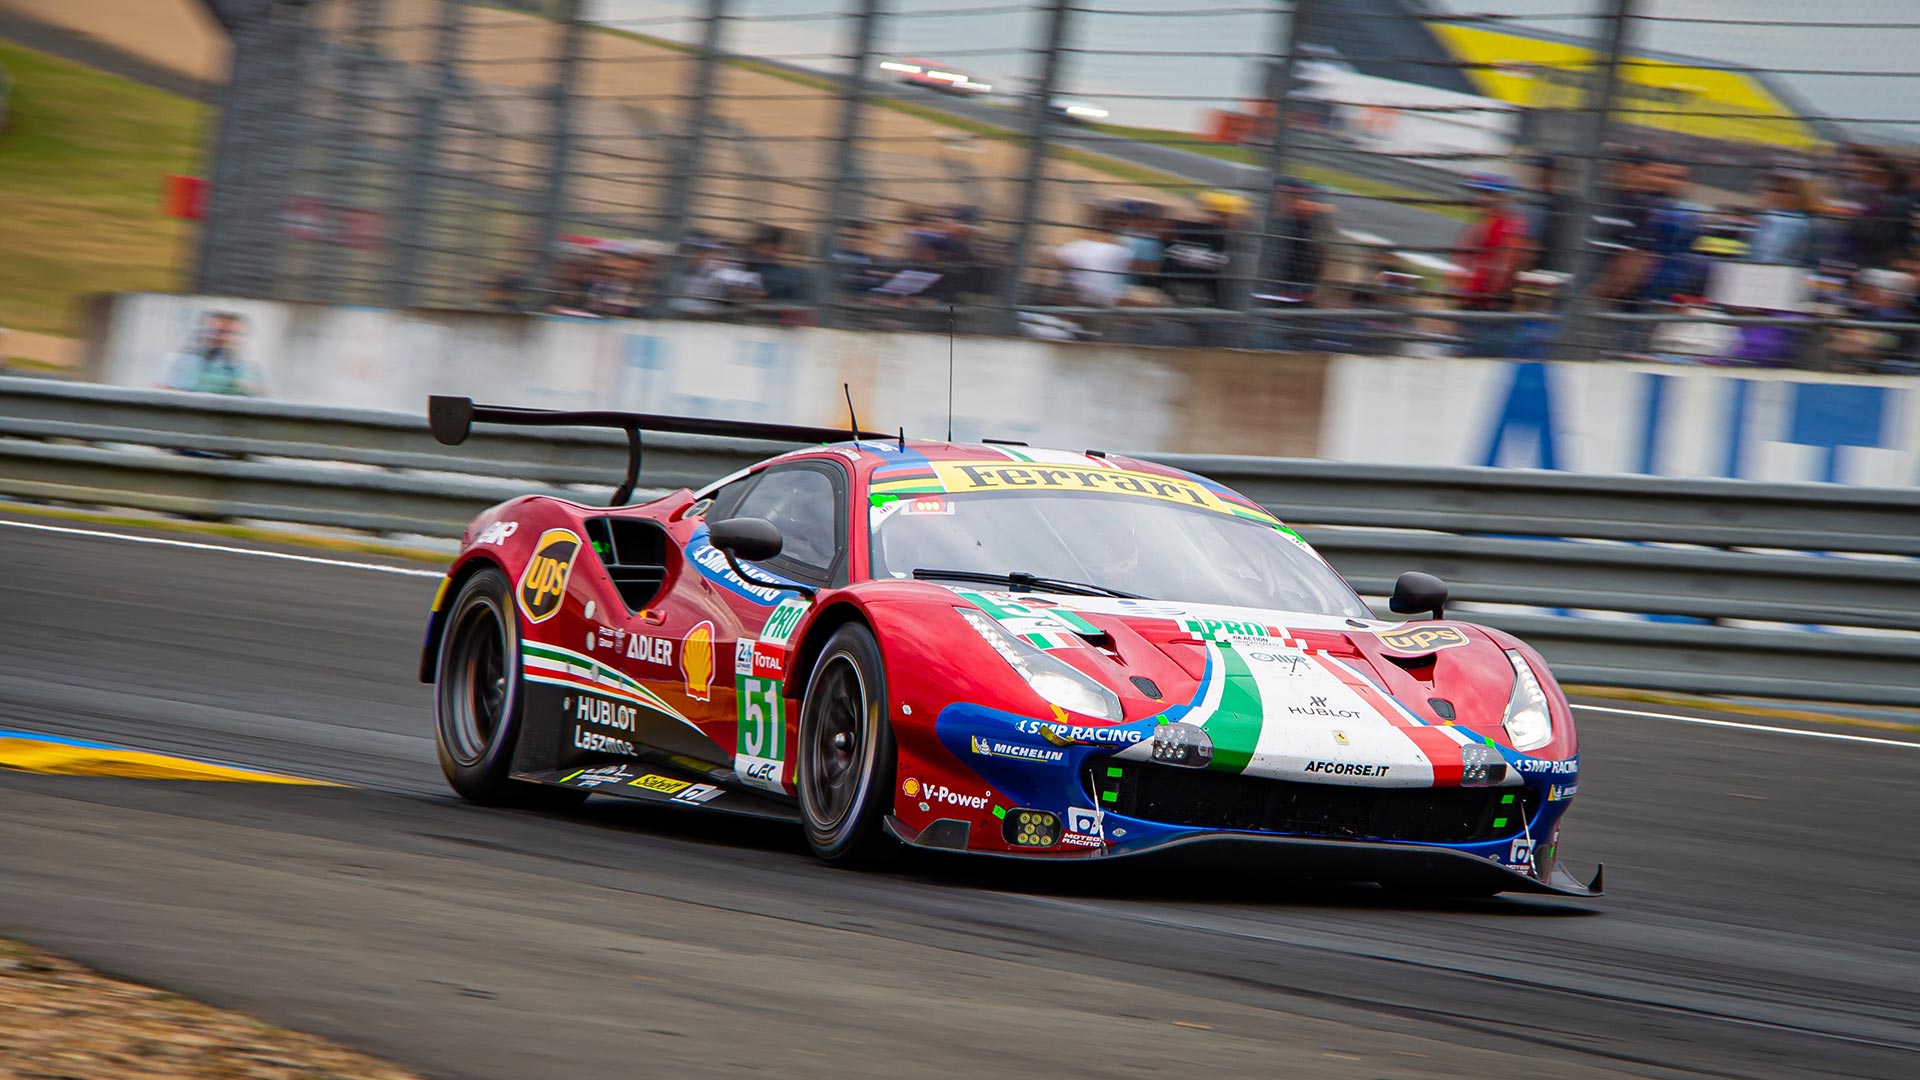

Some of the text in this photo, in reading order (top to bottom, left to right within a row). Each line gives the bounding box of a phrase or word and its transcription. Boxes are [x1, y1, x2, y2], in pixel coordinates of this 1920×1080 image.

[953, 464, 1210, 507] Ferrari
[525, 555, 569, 606] ups
[763, 605, 804, 640] PRO
[626, 633, 673, 667] ADLER
[1387, 628, 1460, 649] ups
[576, 695, 637, 732] HUBLOT
[744, 678, 779, 759] 51
[1288, 706, 1362, 720] HUBLOT
[1070, 726, 1142, 743] RACING
[993, 743, 1064, 761] MICHELIN
[746, 763, 777, 781] WEC
[1304, 760, 1390, 777] AFCORSE.IT
[1523, 758, 1552, 773] SMP
[922, 783, 989, 810] V-Power
